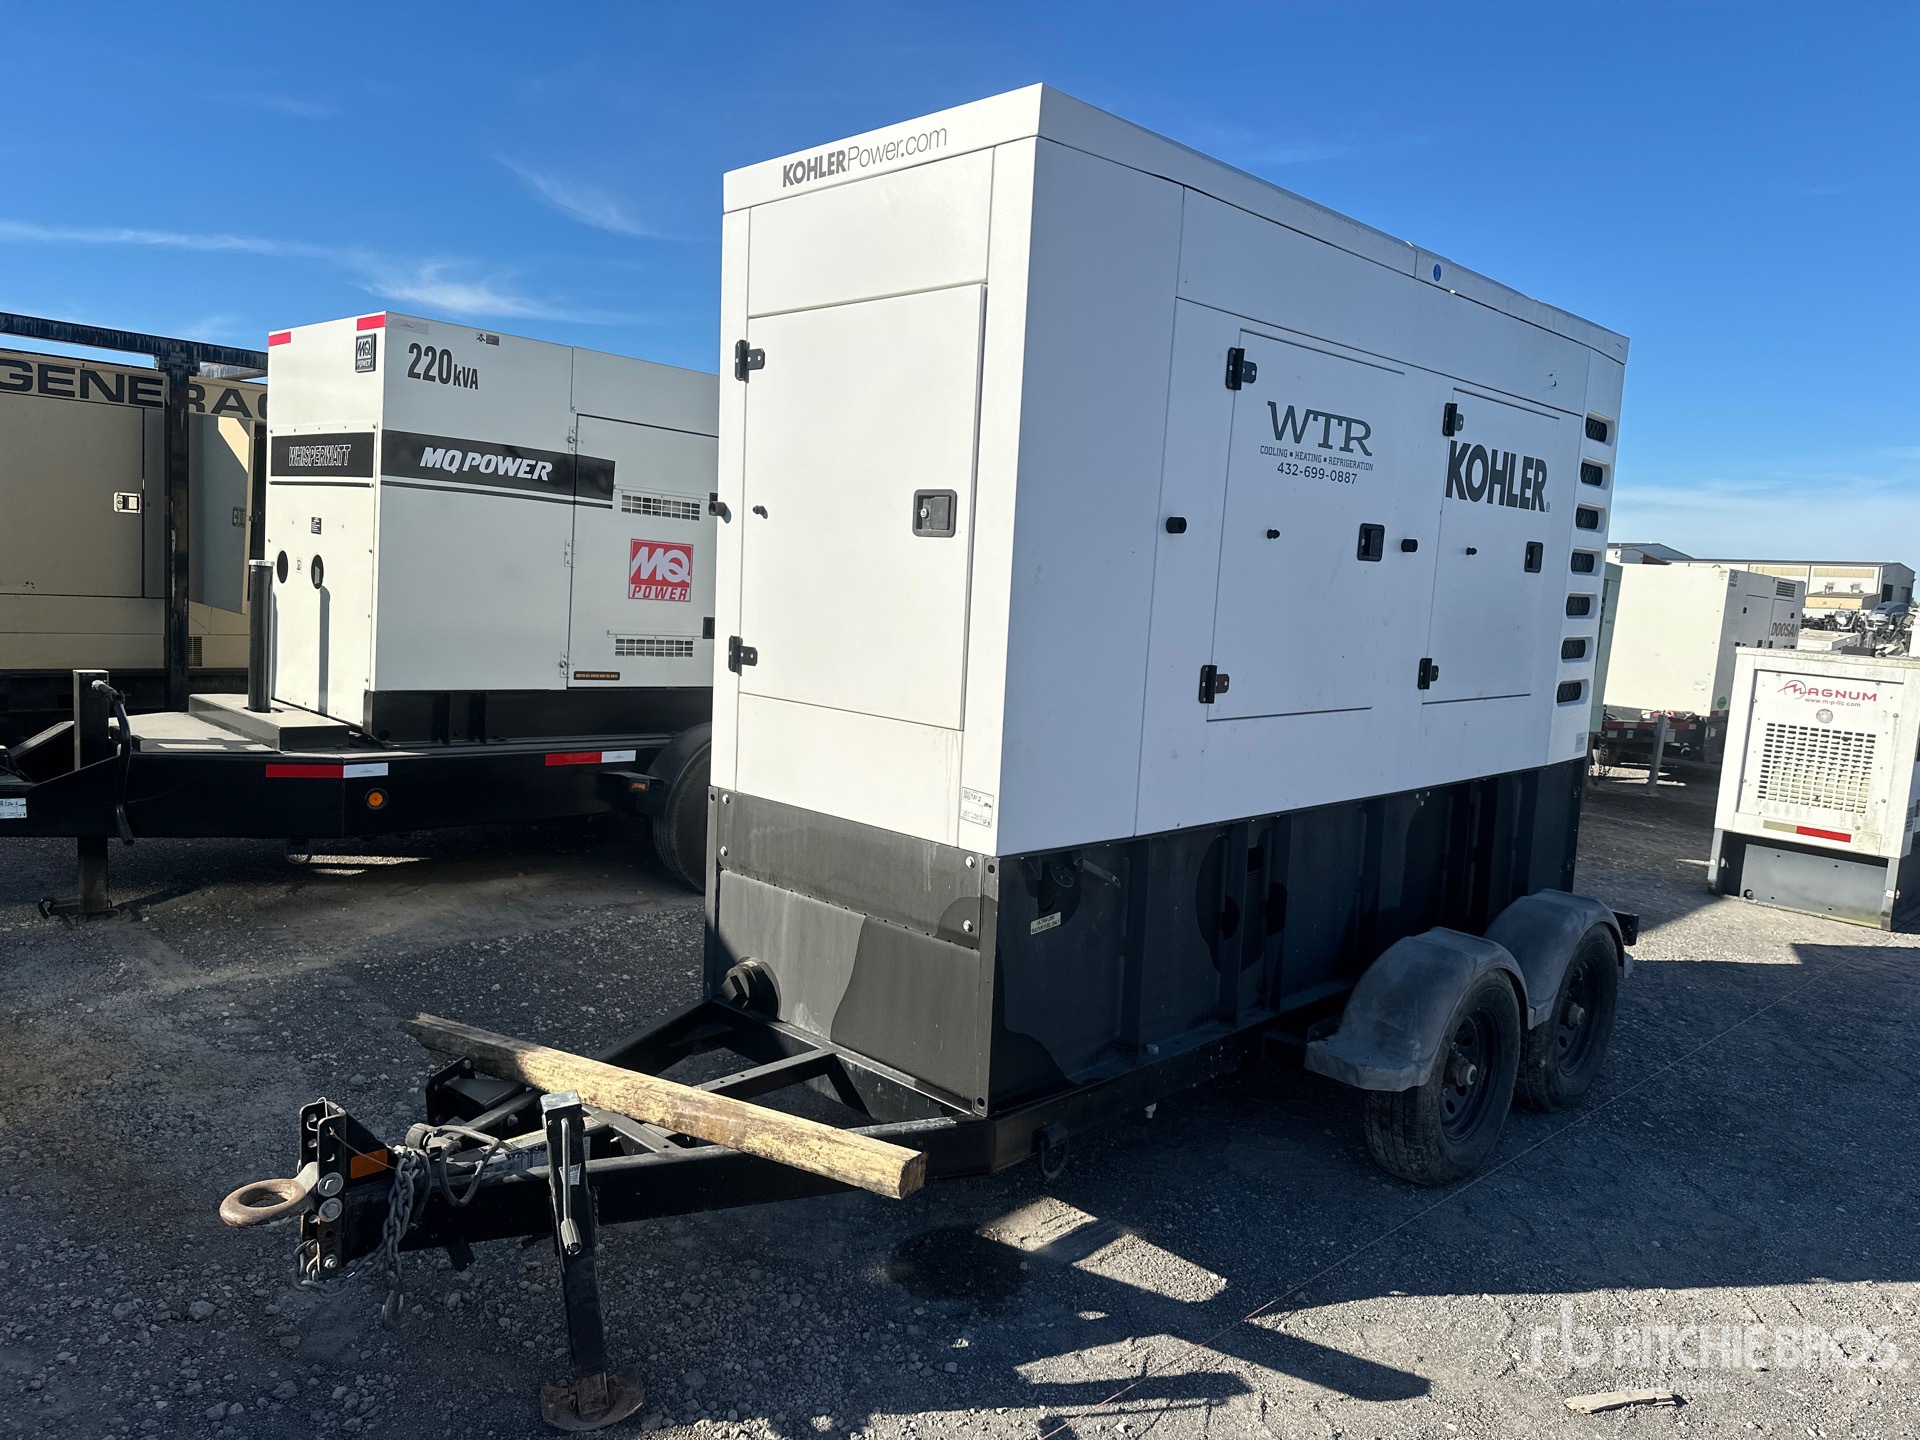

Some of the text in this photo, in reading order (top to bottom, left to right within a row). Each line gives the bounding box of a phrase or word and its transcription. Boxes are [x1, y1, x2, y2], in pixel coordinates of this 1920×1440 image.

[782, 127, 948, 188] KOHLERPower.com
[1267, 400, 1373, 457] WTR
[288, 444, 352, 467] WHISPERWATT
[419, 446, 553, 481] MQ POWER
[1260, 445, 1374, 472] COOLING HEATING REFRIGERATION
[1277, 462, 1358, 485] 432-699-0887
[1445, 439, 1548, 513] KOHLER
[630, 546, 691, 584] MQ
[631, 585, 688, 601] POWER
[1777, 679, 1878, 702] MAGNUM
